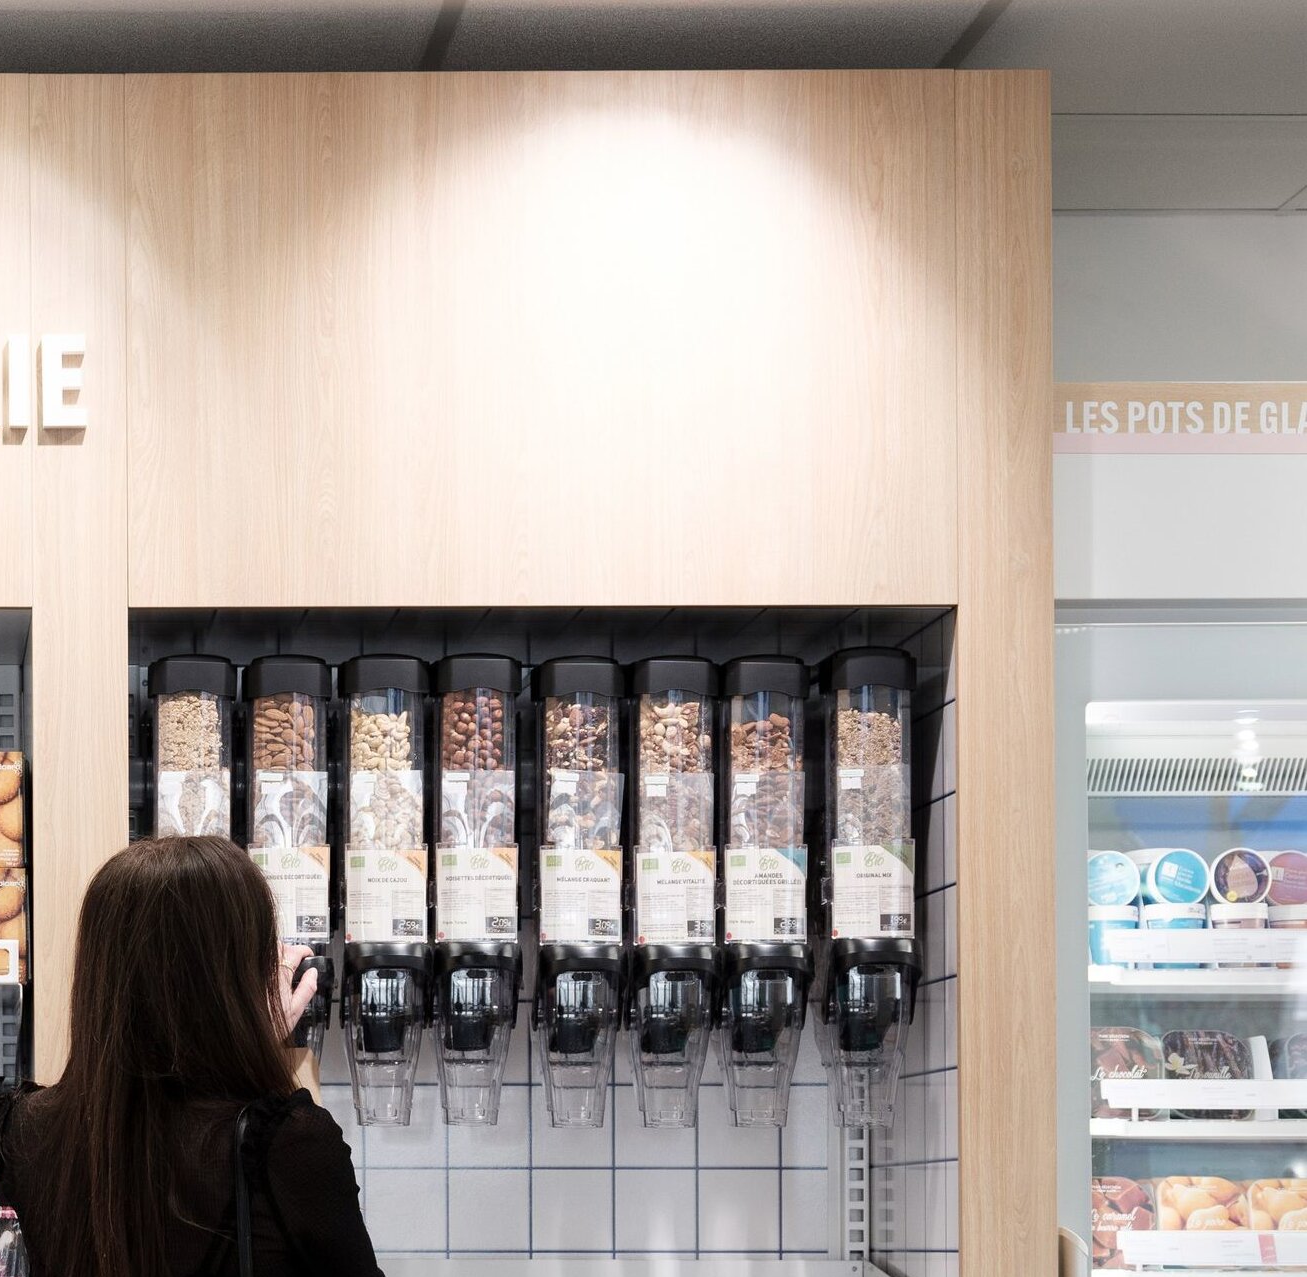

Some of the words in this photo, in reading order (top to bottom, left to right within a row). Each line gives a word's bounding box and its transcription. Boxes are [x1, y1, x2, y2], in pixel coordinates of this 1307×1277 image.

[1066, 401, 1119, 434] LES
[1128, 401, 1204, 434] POTS
[1213, 401, 1251, 434] DE
